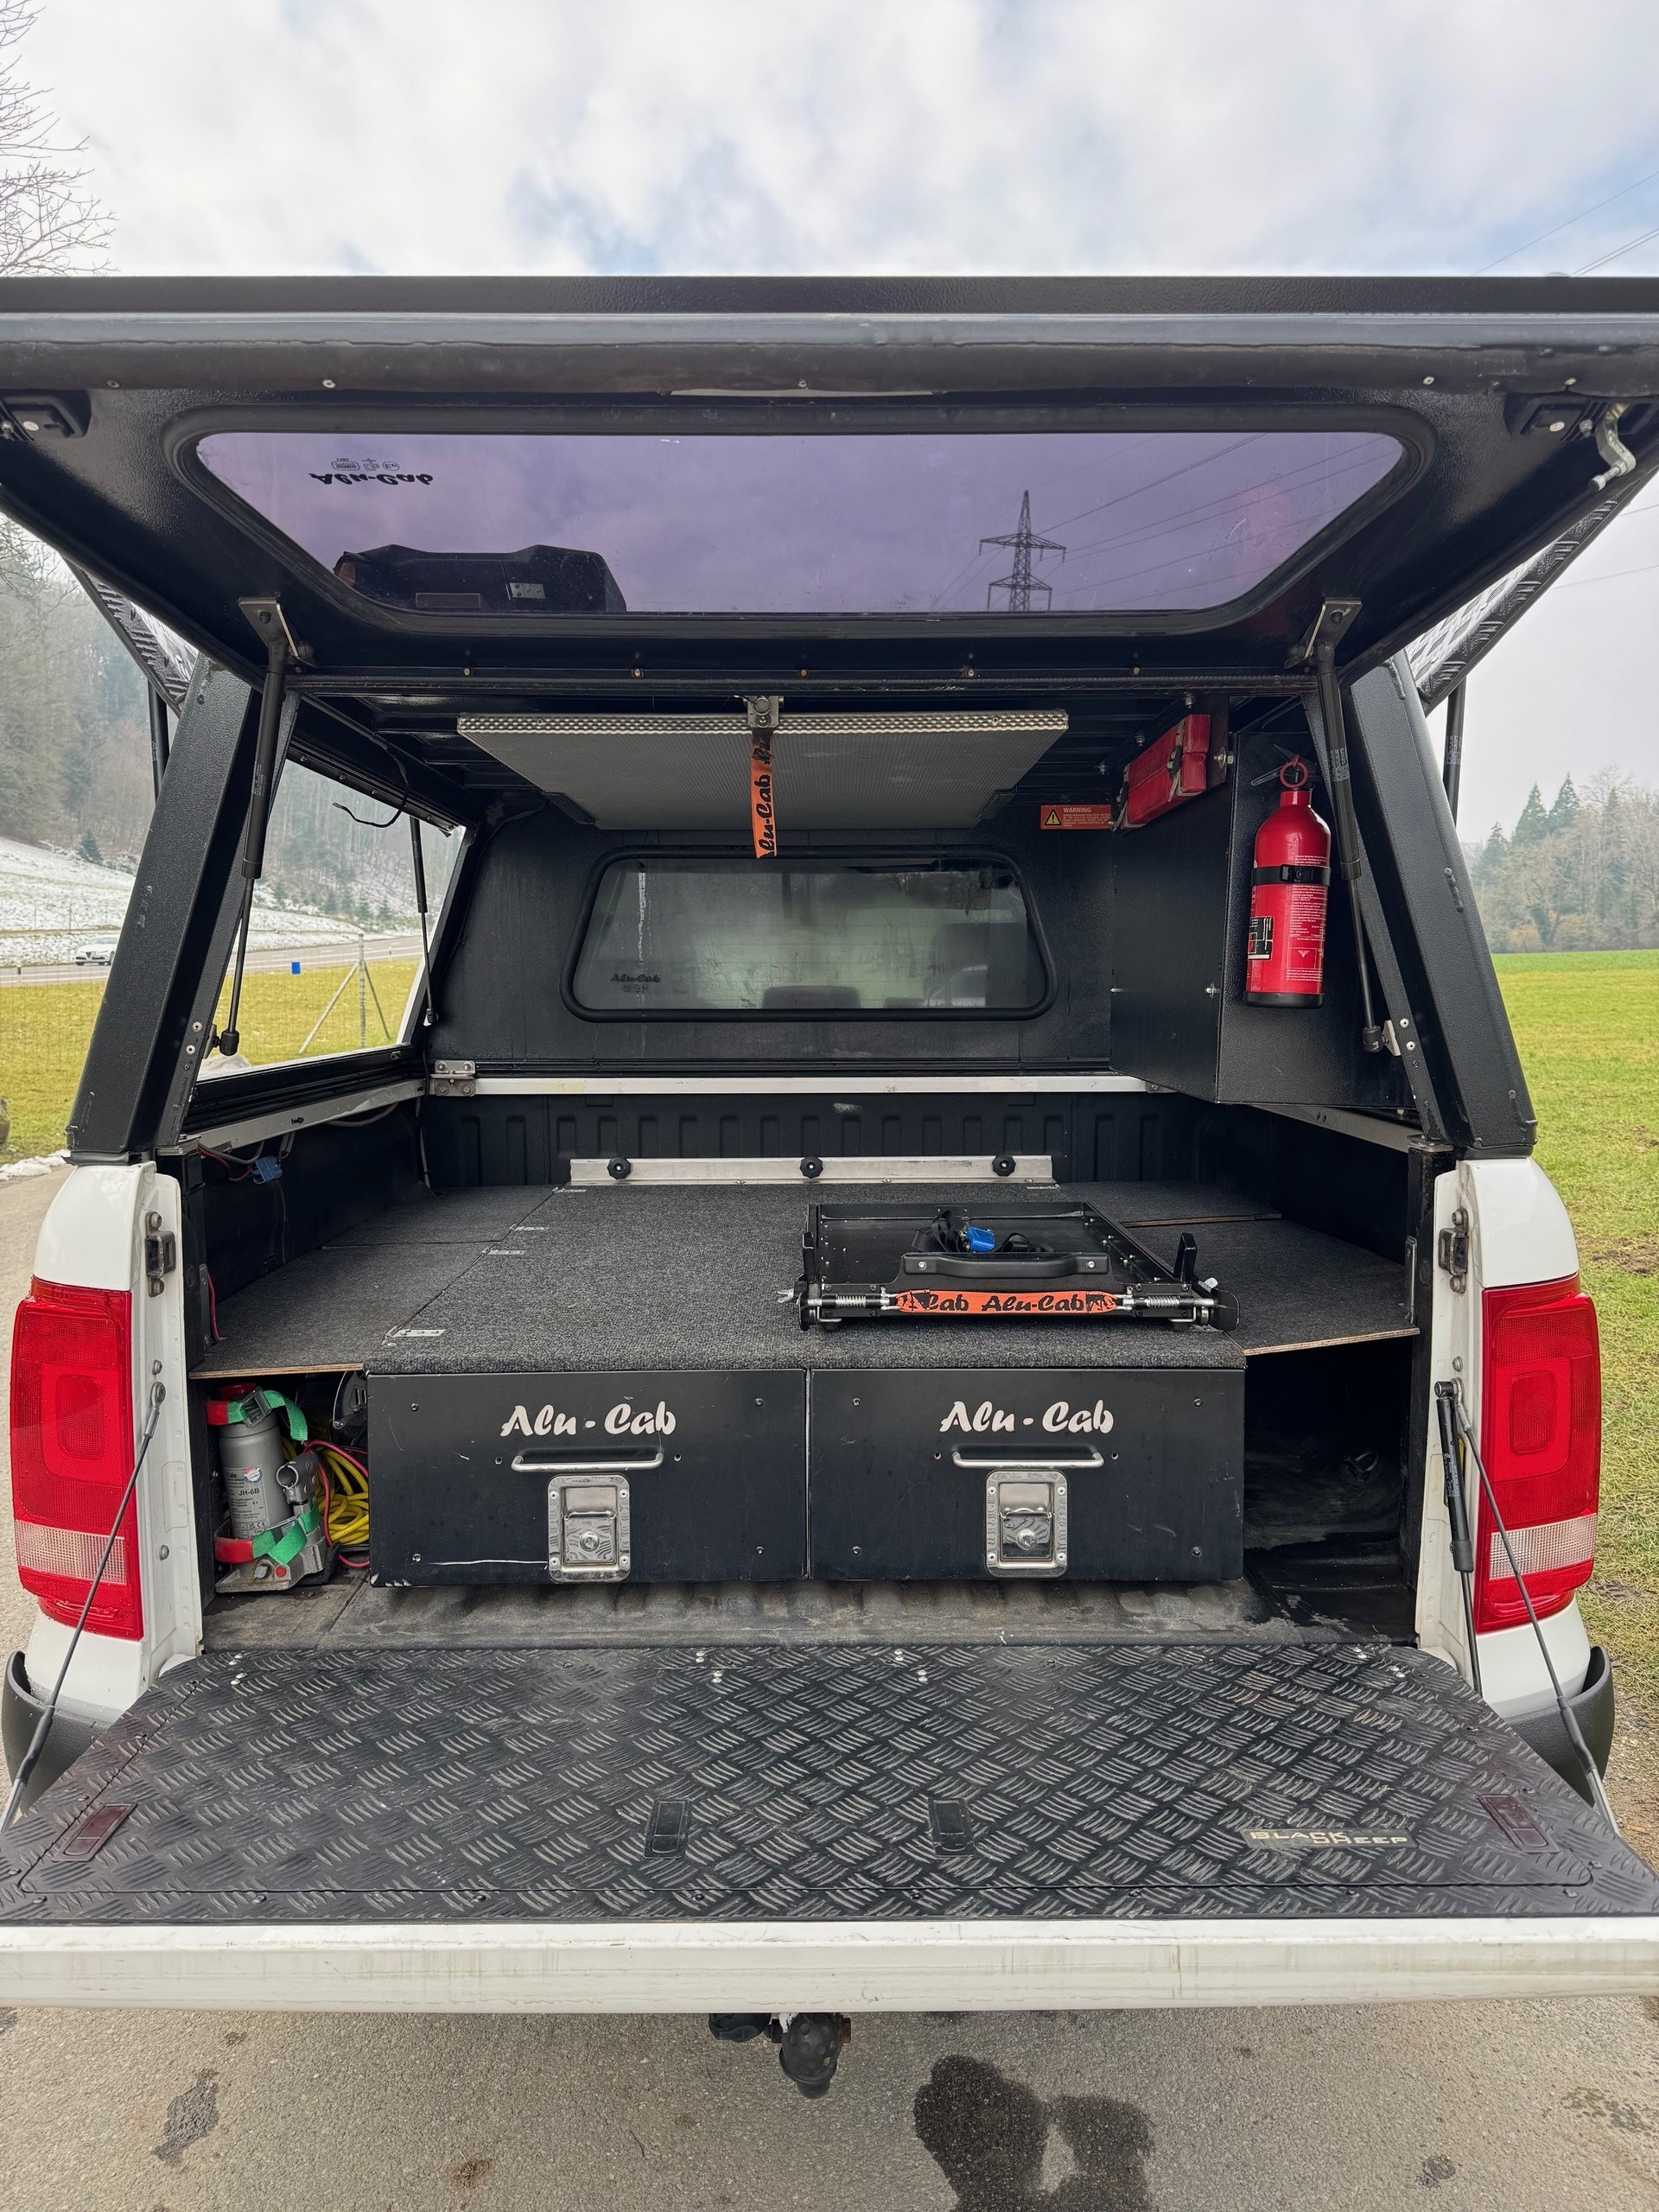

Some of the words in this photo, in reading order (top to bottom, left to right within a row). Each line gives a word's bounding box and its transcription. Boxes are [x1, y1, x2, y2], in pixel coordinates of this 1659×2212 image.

[610, 974, 660, 983] Alu-Cab
[981, 1294, 1084, 1312] Alu-Cab
[238, 1487, 260, 1496] JH-6B
[1250, 1831, 1347, 1840] BLACK
